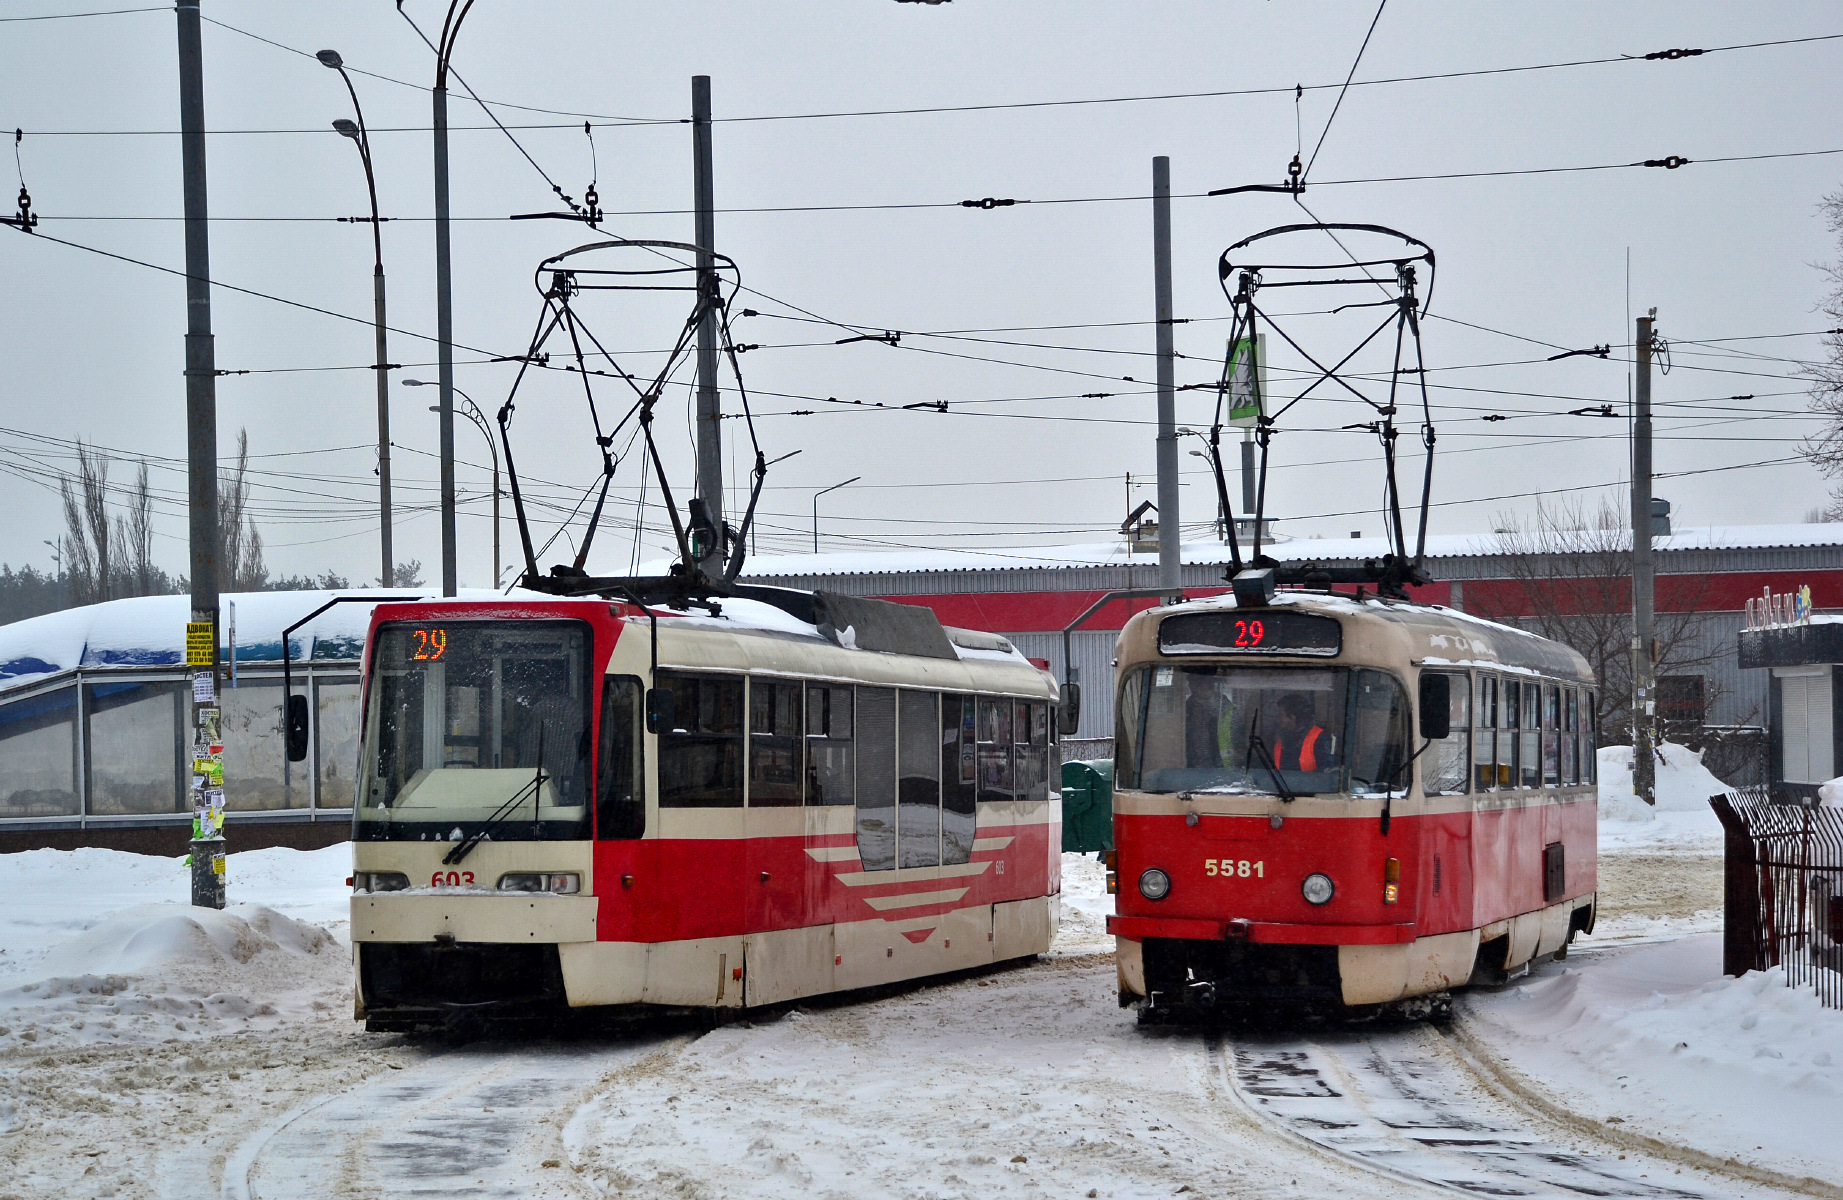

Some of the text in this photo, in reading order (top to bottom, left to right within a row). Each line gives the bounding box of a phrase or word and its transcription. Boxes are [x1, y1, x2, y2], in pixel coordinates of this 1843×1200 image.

[1234, 620, 1264, 647] 29
[413, 629, 446, 660] 29
[996, 860, 1004, 875] 603
[1205, 859, 1264, 878] 5581
[431, 871, 475, 888] 603
